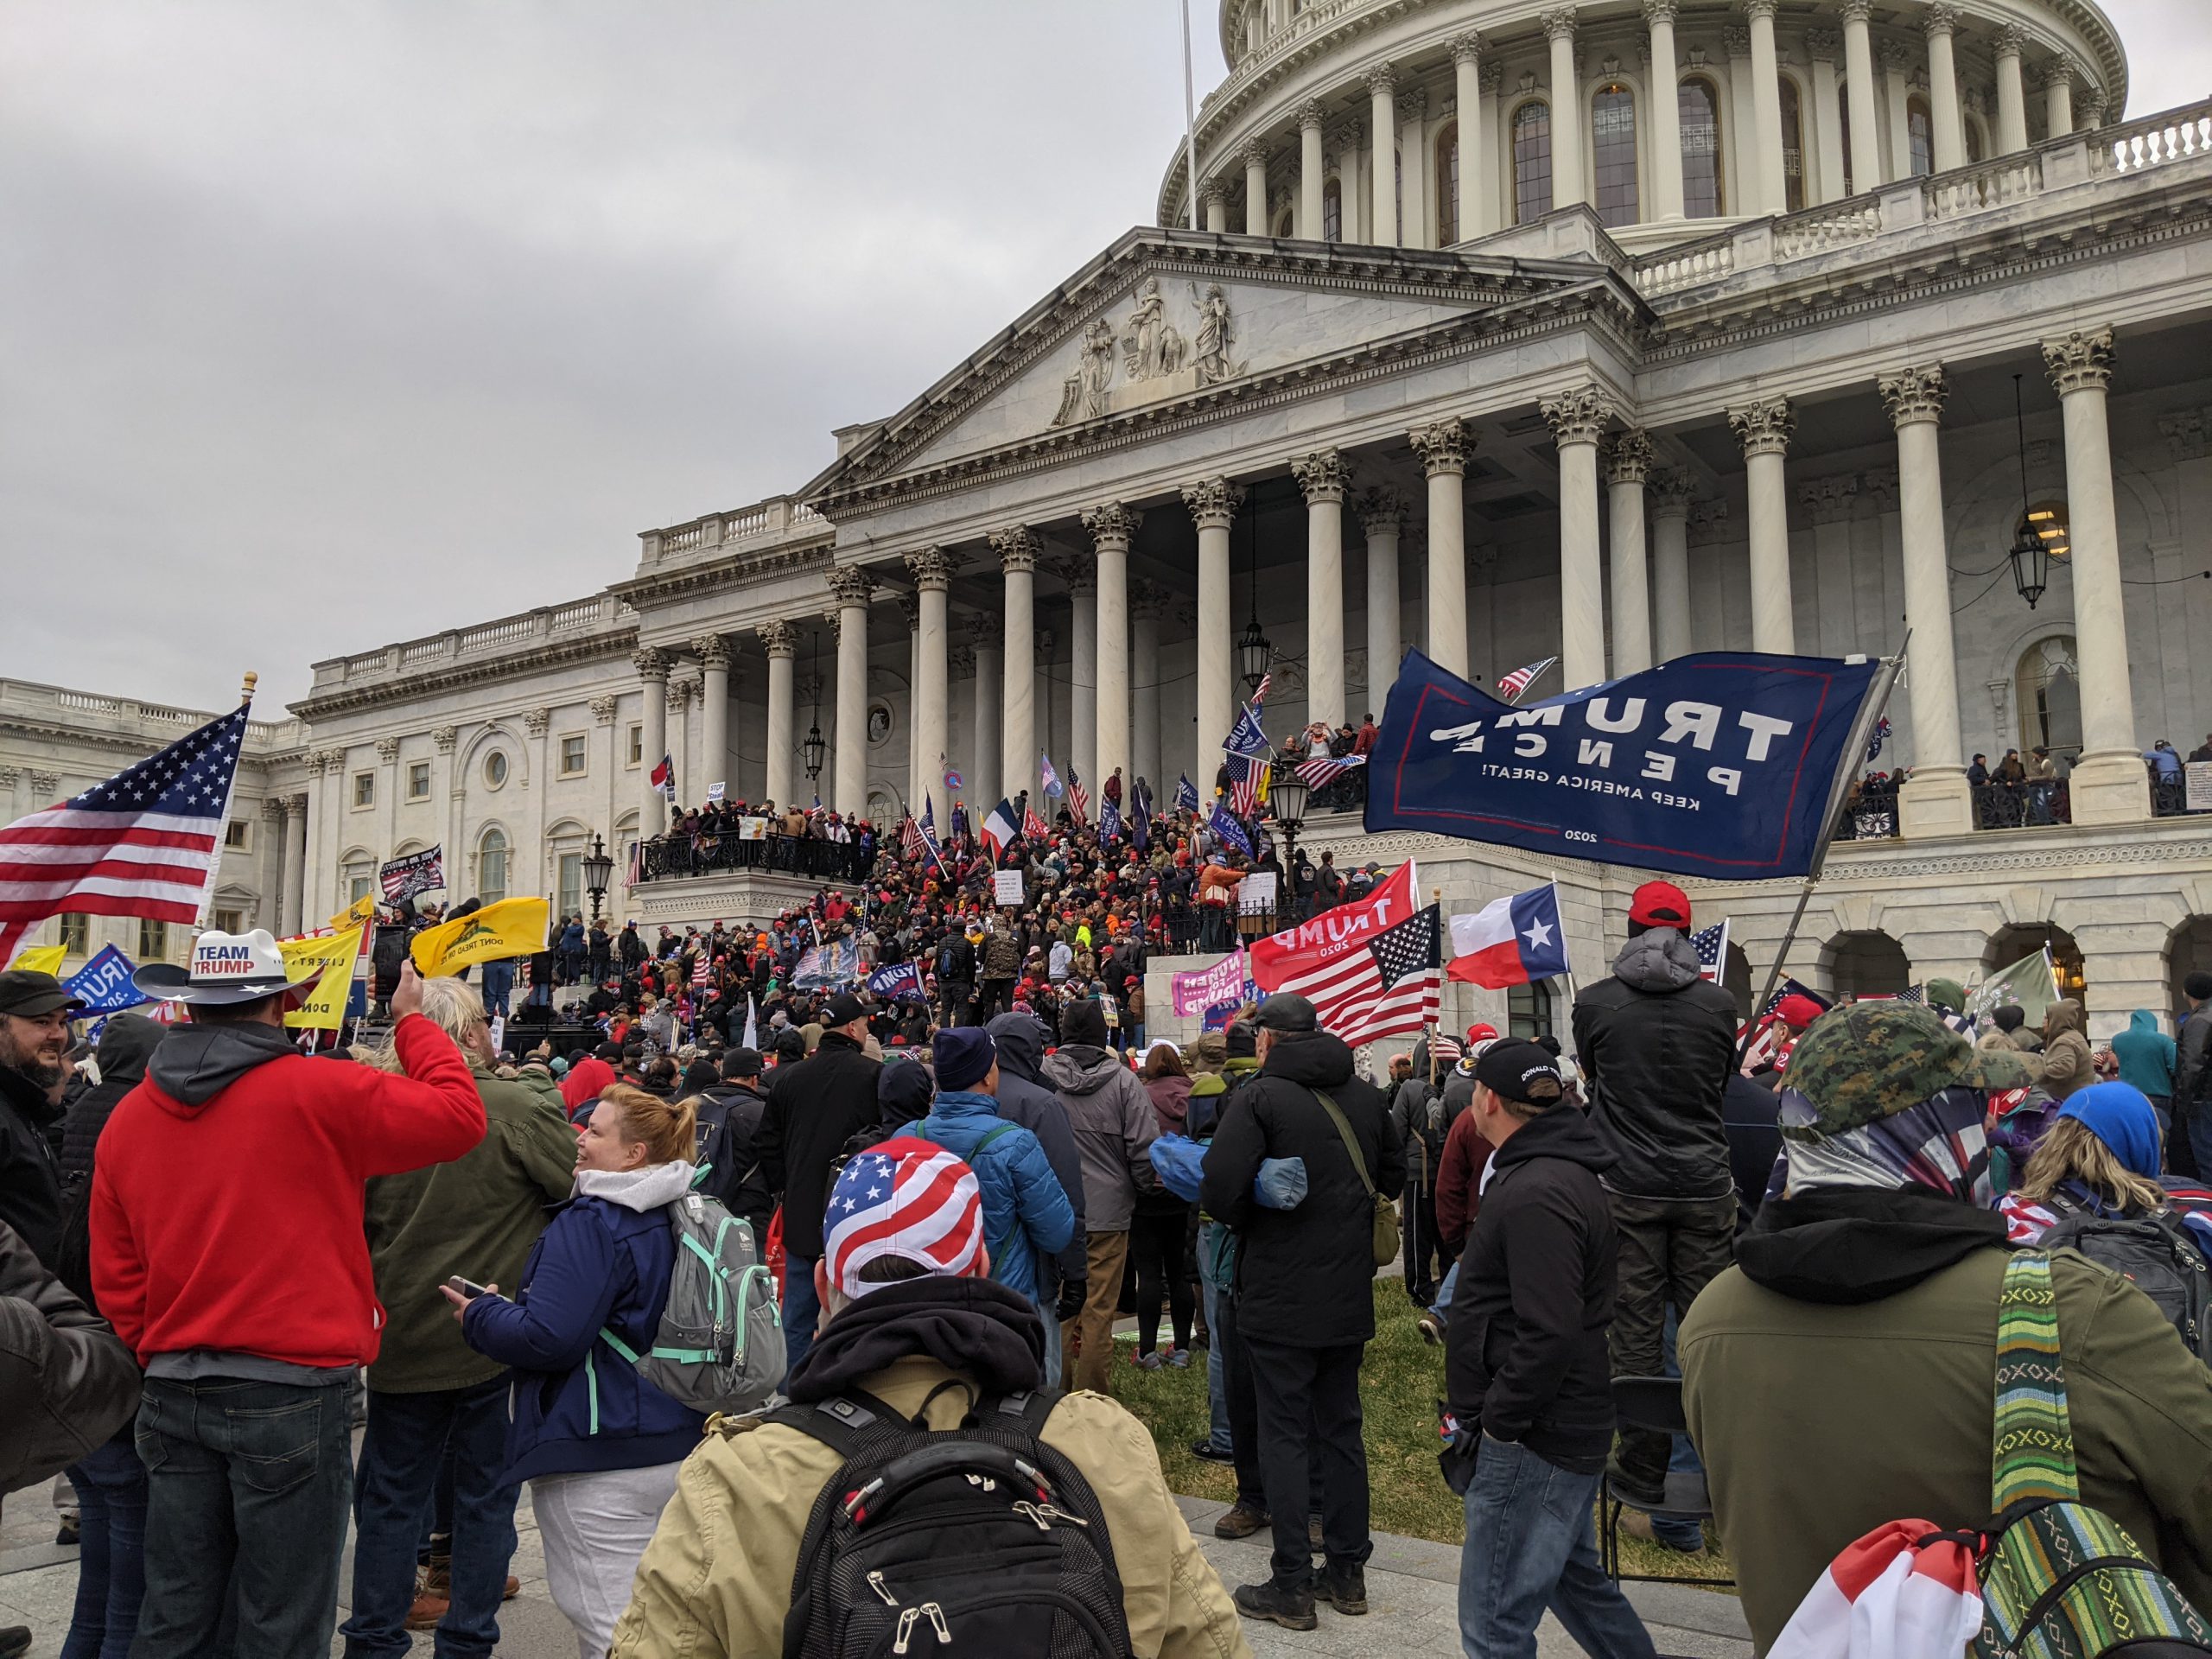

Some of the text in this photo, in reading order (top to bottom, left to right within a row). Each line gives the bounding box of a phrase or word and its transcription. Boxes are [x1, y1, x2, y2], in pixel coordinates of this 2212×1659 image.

[1227, 830, 1246, 845] 2020
[198, 946, 249, 960] TEAM
[194, 960, 255, 975] TRUMP
[1521, 1065, 1548, 1082] DONALD
